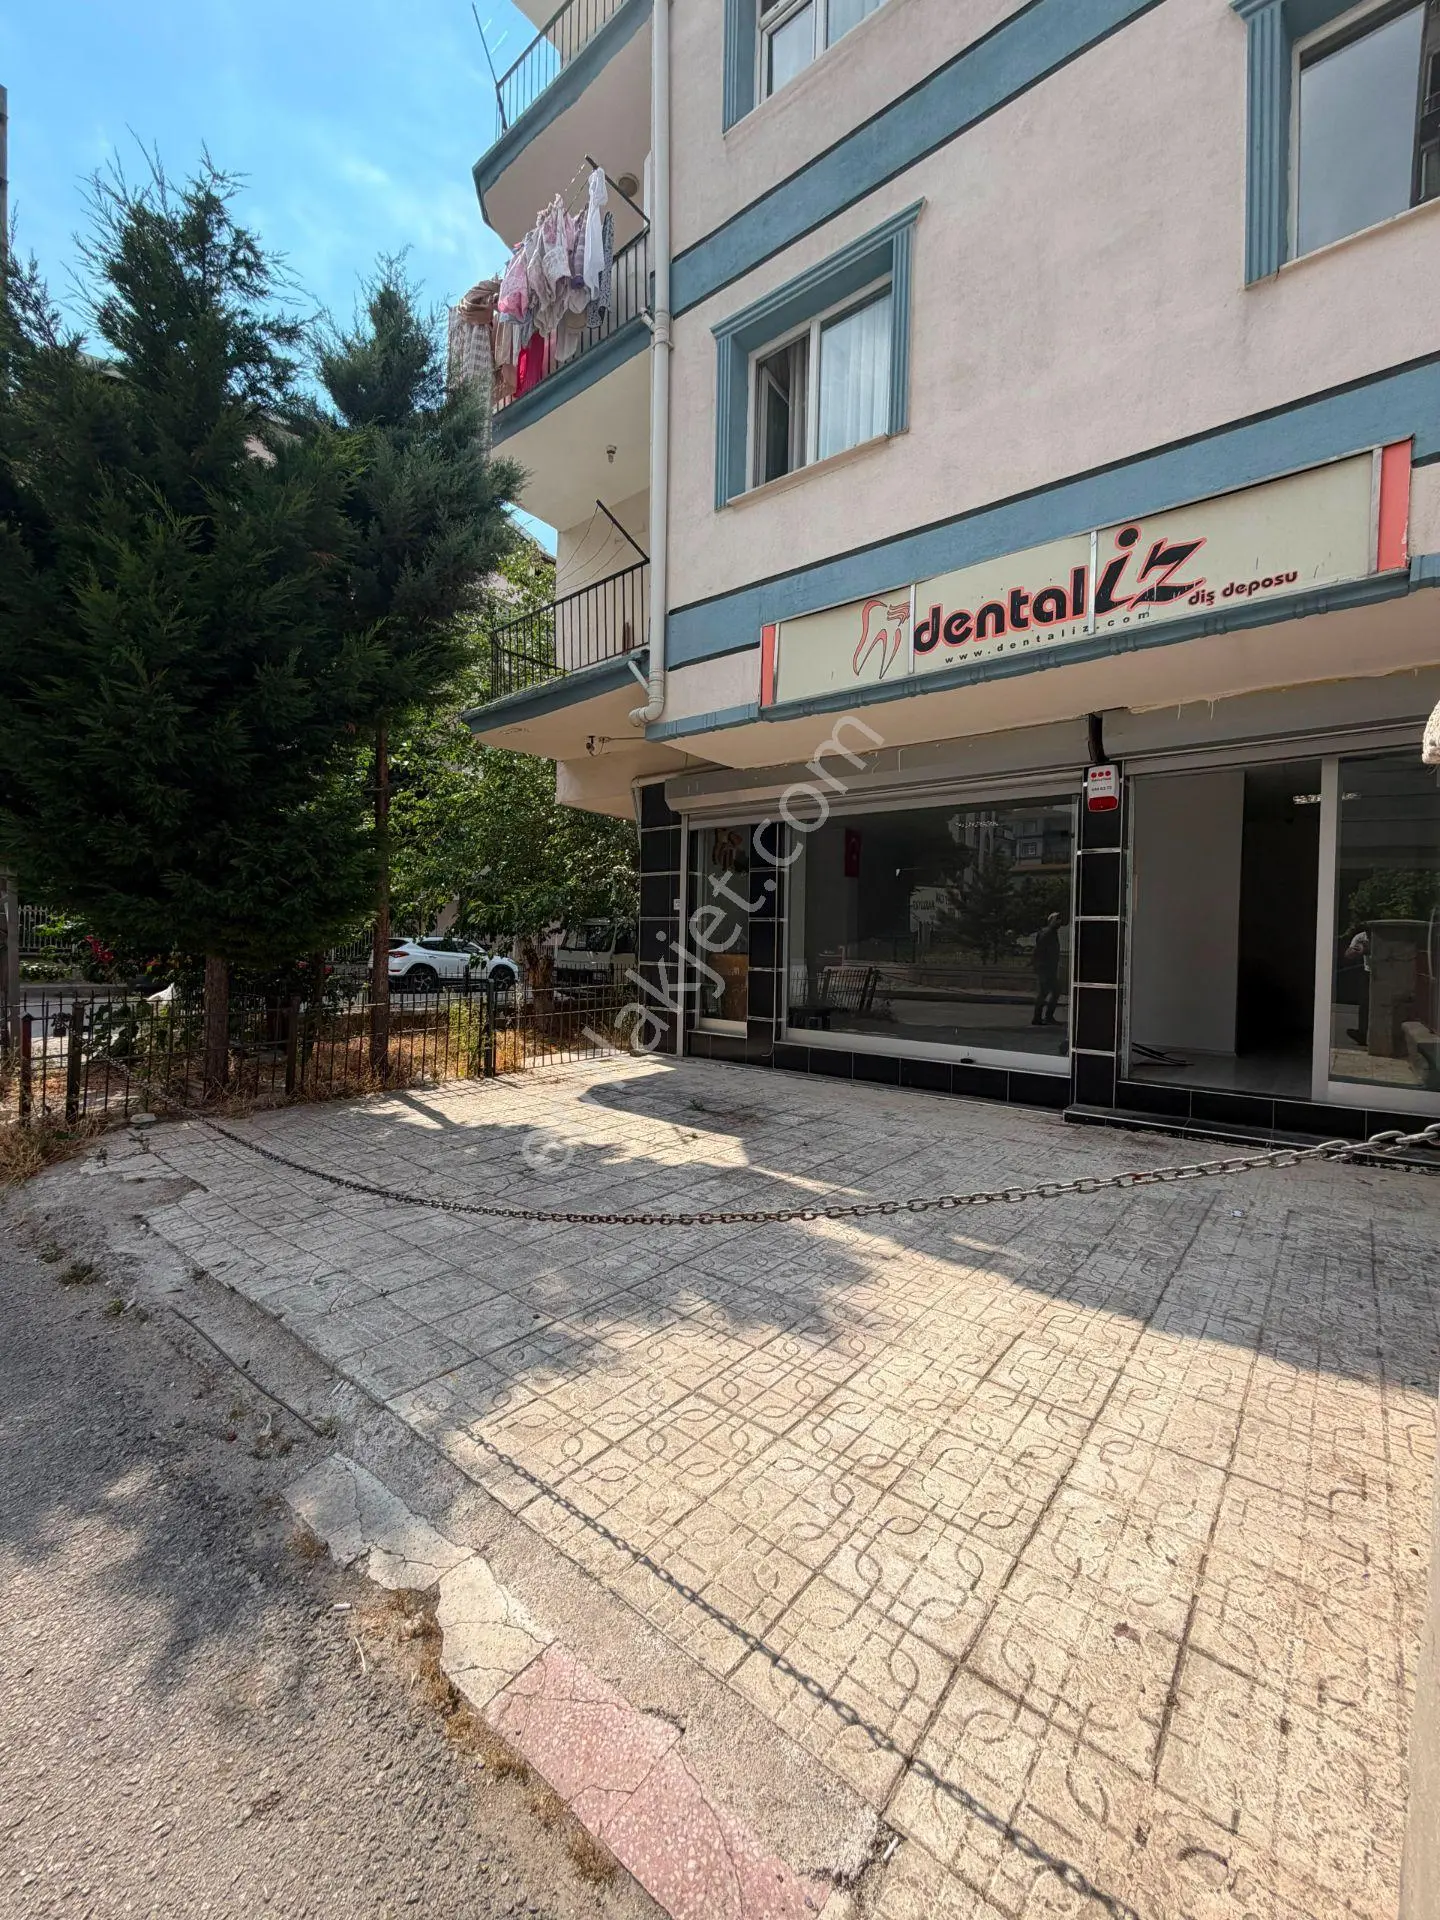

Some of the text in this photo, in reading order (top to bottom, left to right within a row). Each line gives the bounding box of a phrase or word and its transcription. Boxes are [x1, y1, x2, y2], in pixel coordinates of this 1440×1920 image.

[1187, 570, 1298, 606] diş deposu
[944, 611, 1150, 664] www.dentaliz.com
